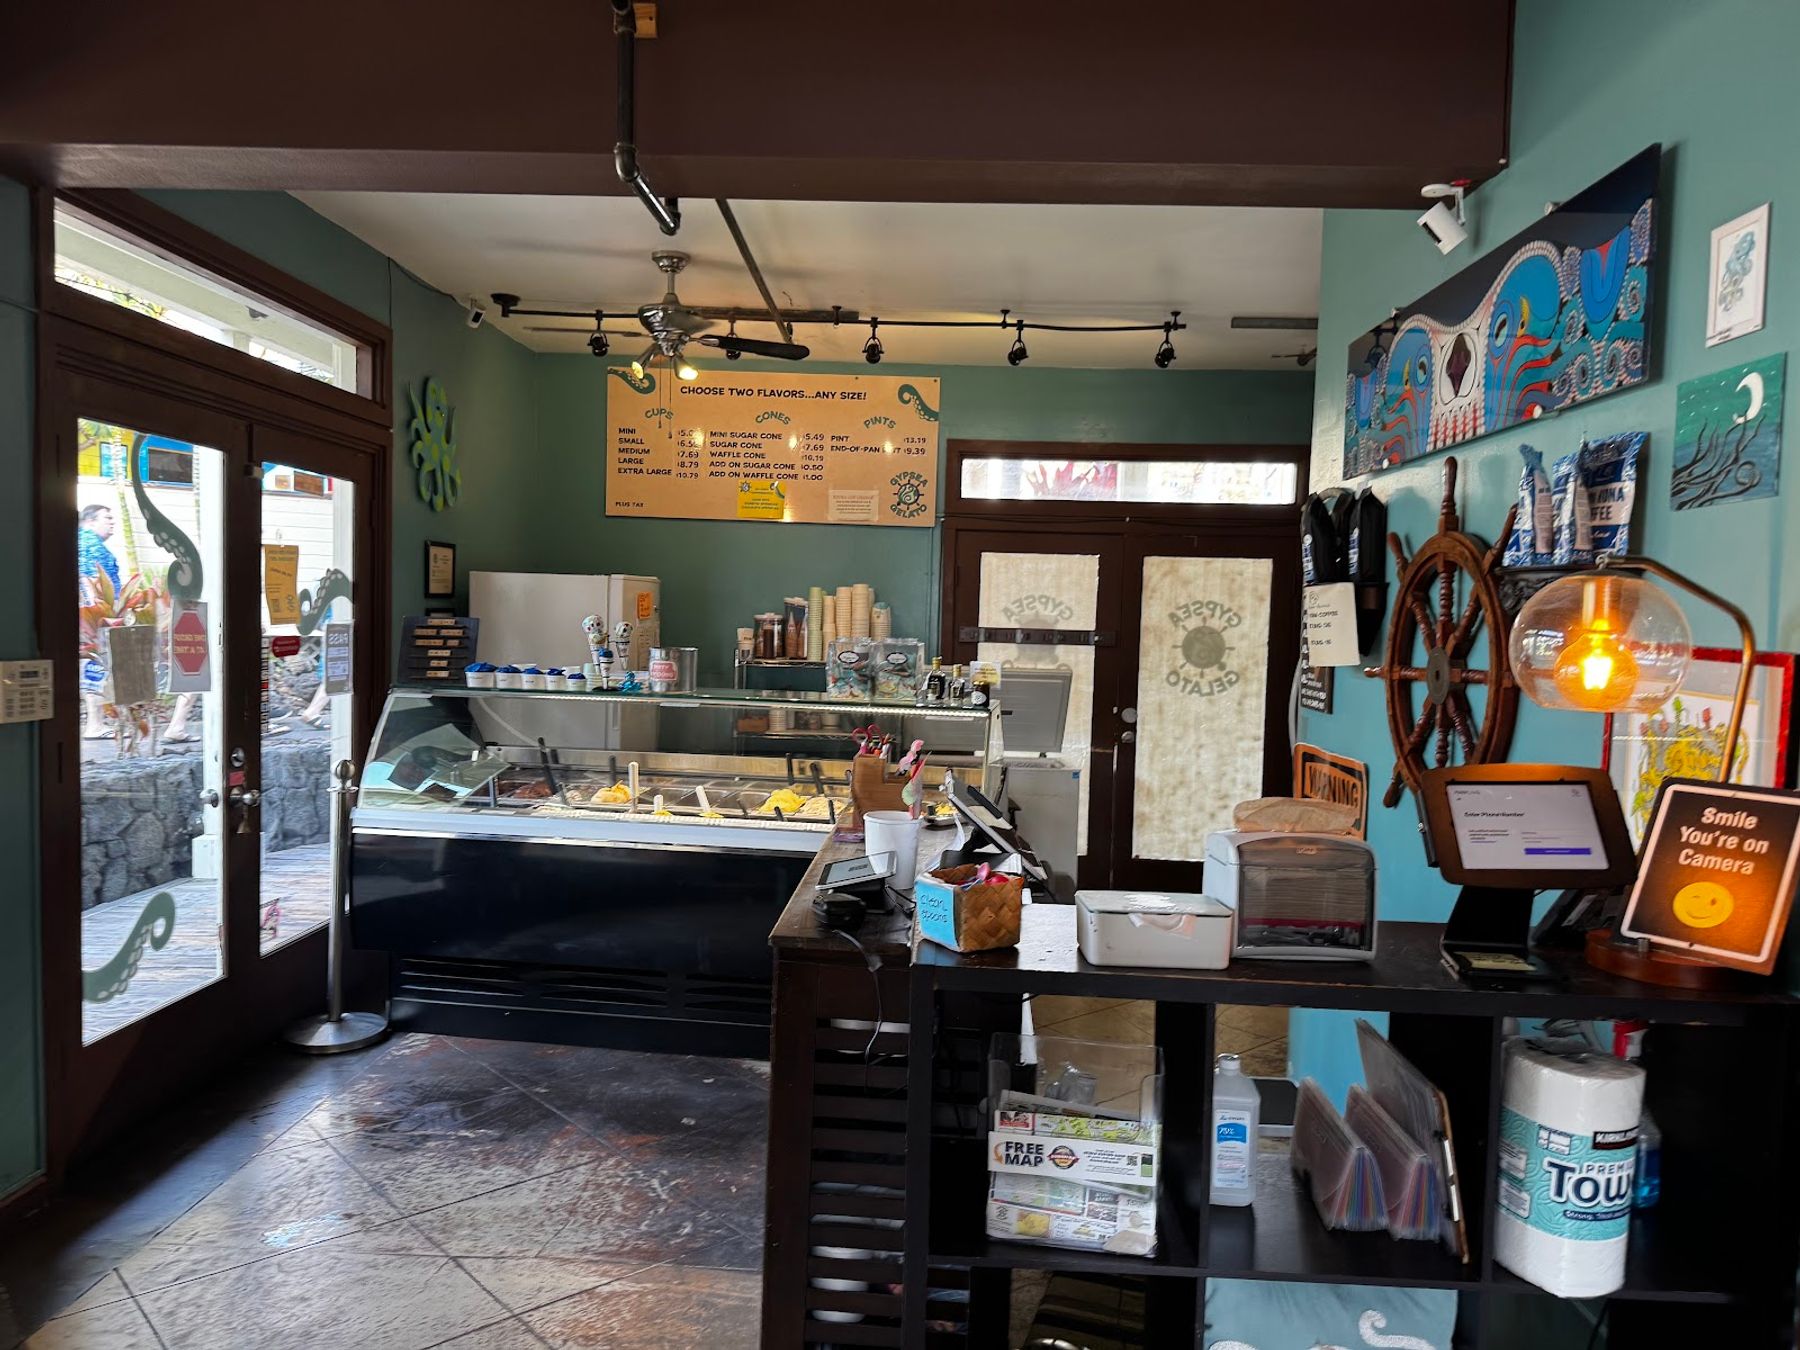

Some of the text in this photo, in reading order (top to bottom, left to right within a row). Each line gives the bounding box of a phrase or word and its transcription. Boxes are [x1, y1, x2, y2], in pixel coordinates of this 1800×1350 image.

[680, 386, 867, 401] CHOOSE TWO FLAVORS...ANY SIZE!
[645, 408, 674, 420] CUPS
[755, 411, 791, 425] CONES
[863, 416, 896, 429] PINTS
[830, 445, 880, 453] END-OF-PAN
[646, 468, 672, 476] LARGE
[742, 472, 774, 480] WAFFLE
[890, 471, 929, 488] GYPSEA
[890, 503, 928, 519] GELATO
[1701, 806, 1759, 830] Smile
[1680, 825, 1770, 855] You're on
[1678, 848, 1756, 876] Camera
[1004, 1141, 1045, 1156] FREE
[1004, 1153, 1044, 1168] MAP
